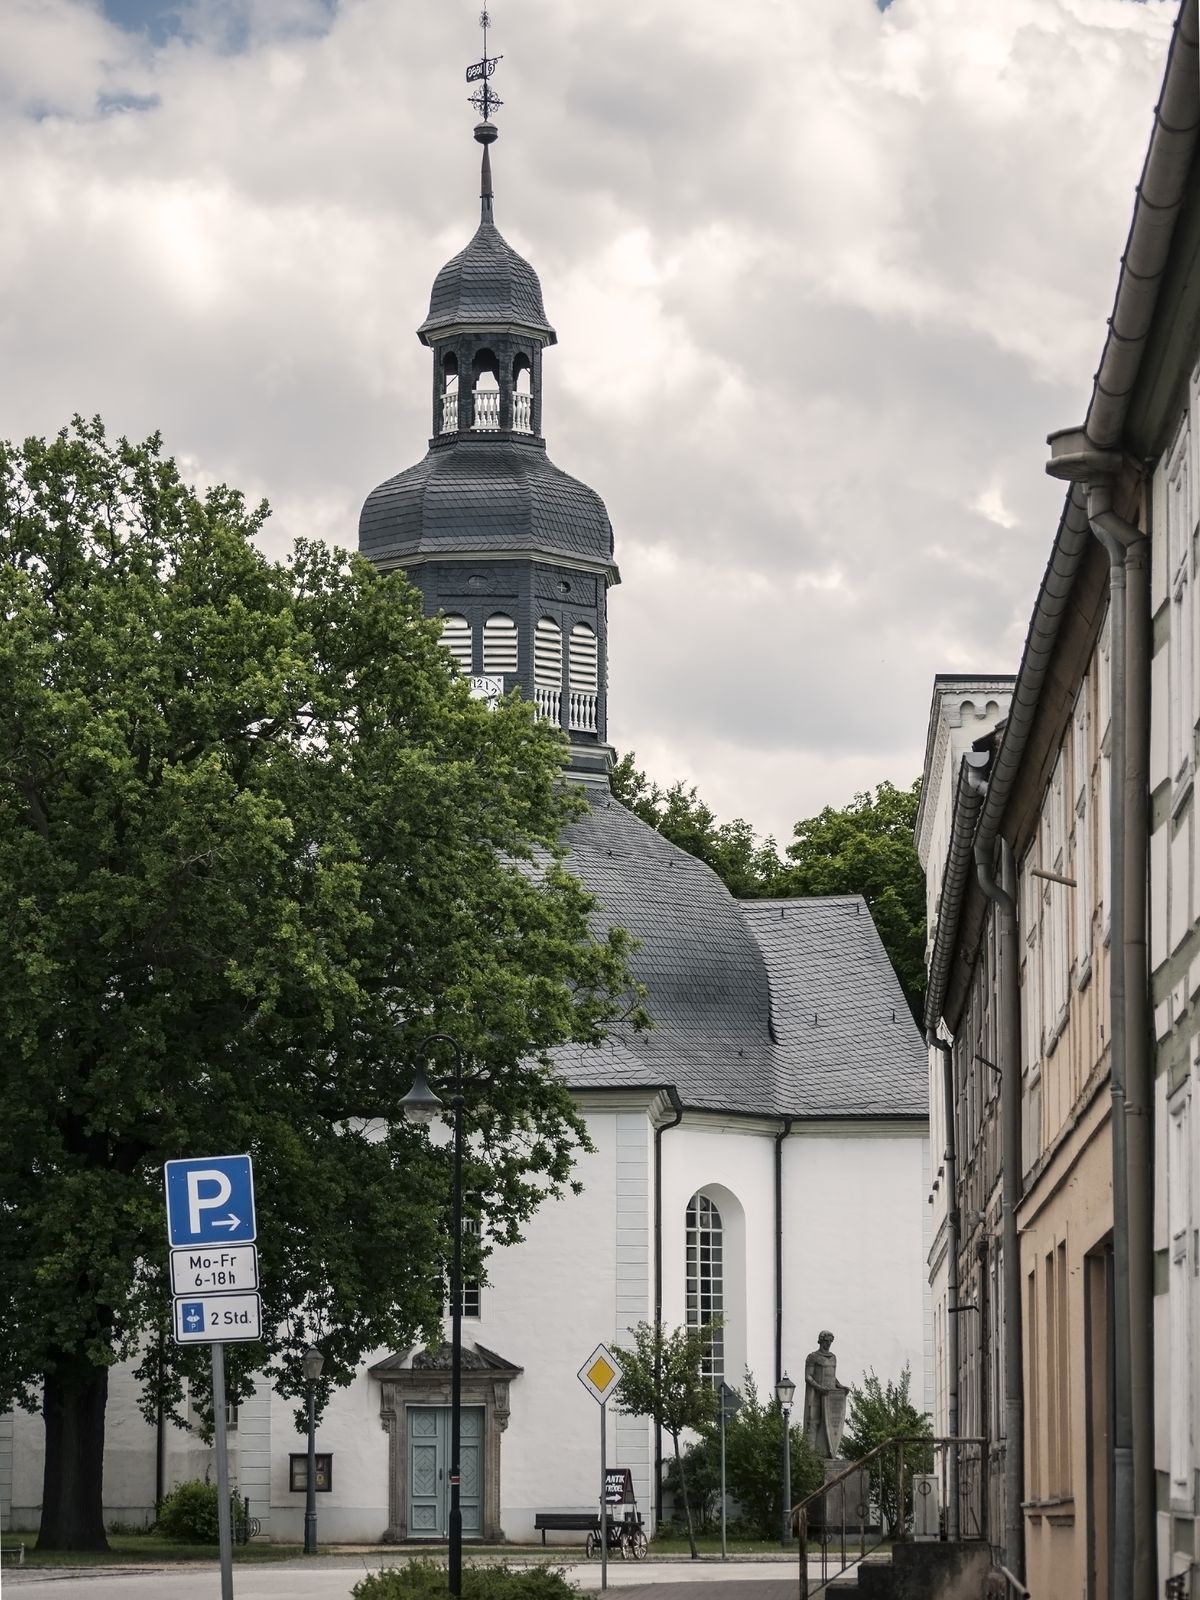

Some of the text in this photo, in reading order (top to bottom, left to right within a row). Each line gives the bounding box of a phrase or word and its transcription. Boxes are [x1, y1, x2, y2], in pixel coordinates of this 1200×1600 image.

[187, 1169, 232, 1234] P
[189, 1254, 237, 1270] Mo-Fr
[210, 1310, 252, 1326] 2 Std.
